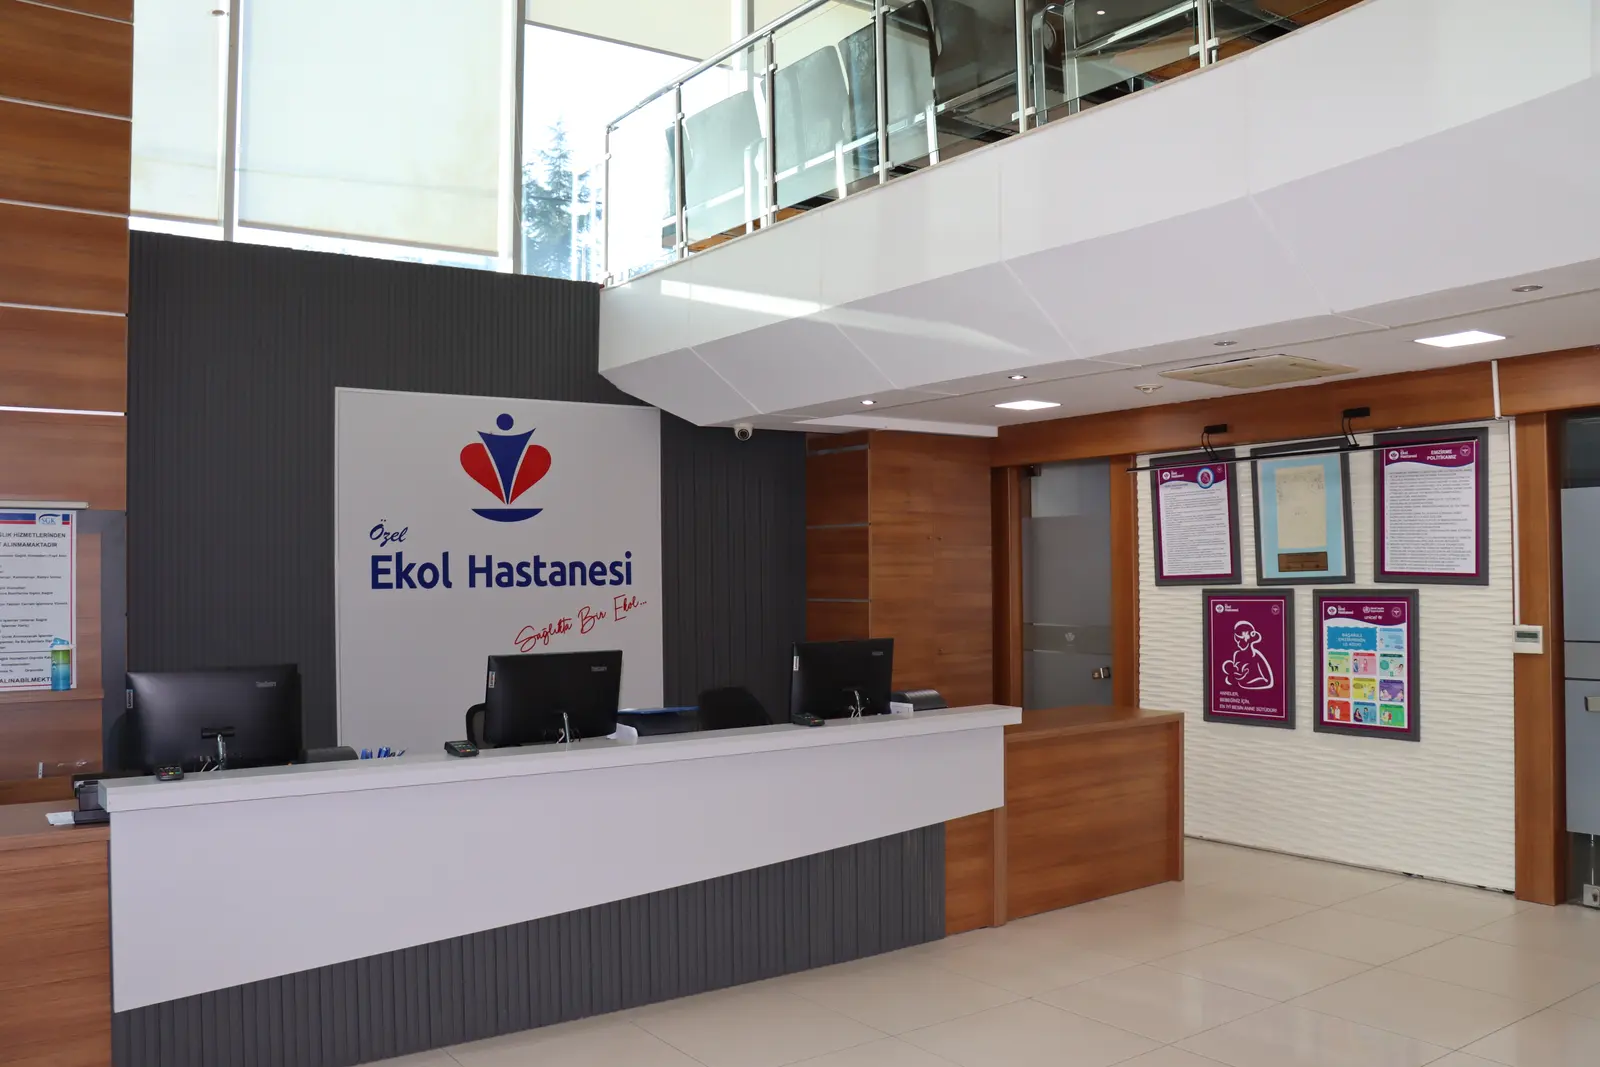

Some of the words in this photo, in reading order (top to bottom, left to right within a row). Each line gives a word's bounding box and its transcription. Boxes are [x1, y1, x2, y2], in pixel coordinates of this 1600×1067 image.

[369, 519, 408, 547] Özel
[371, 551, 452, 589] Ekol
[468, 551, 632, 588] Hastanesi
[577, 605, 607, 634] Bir
